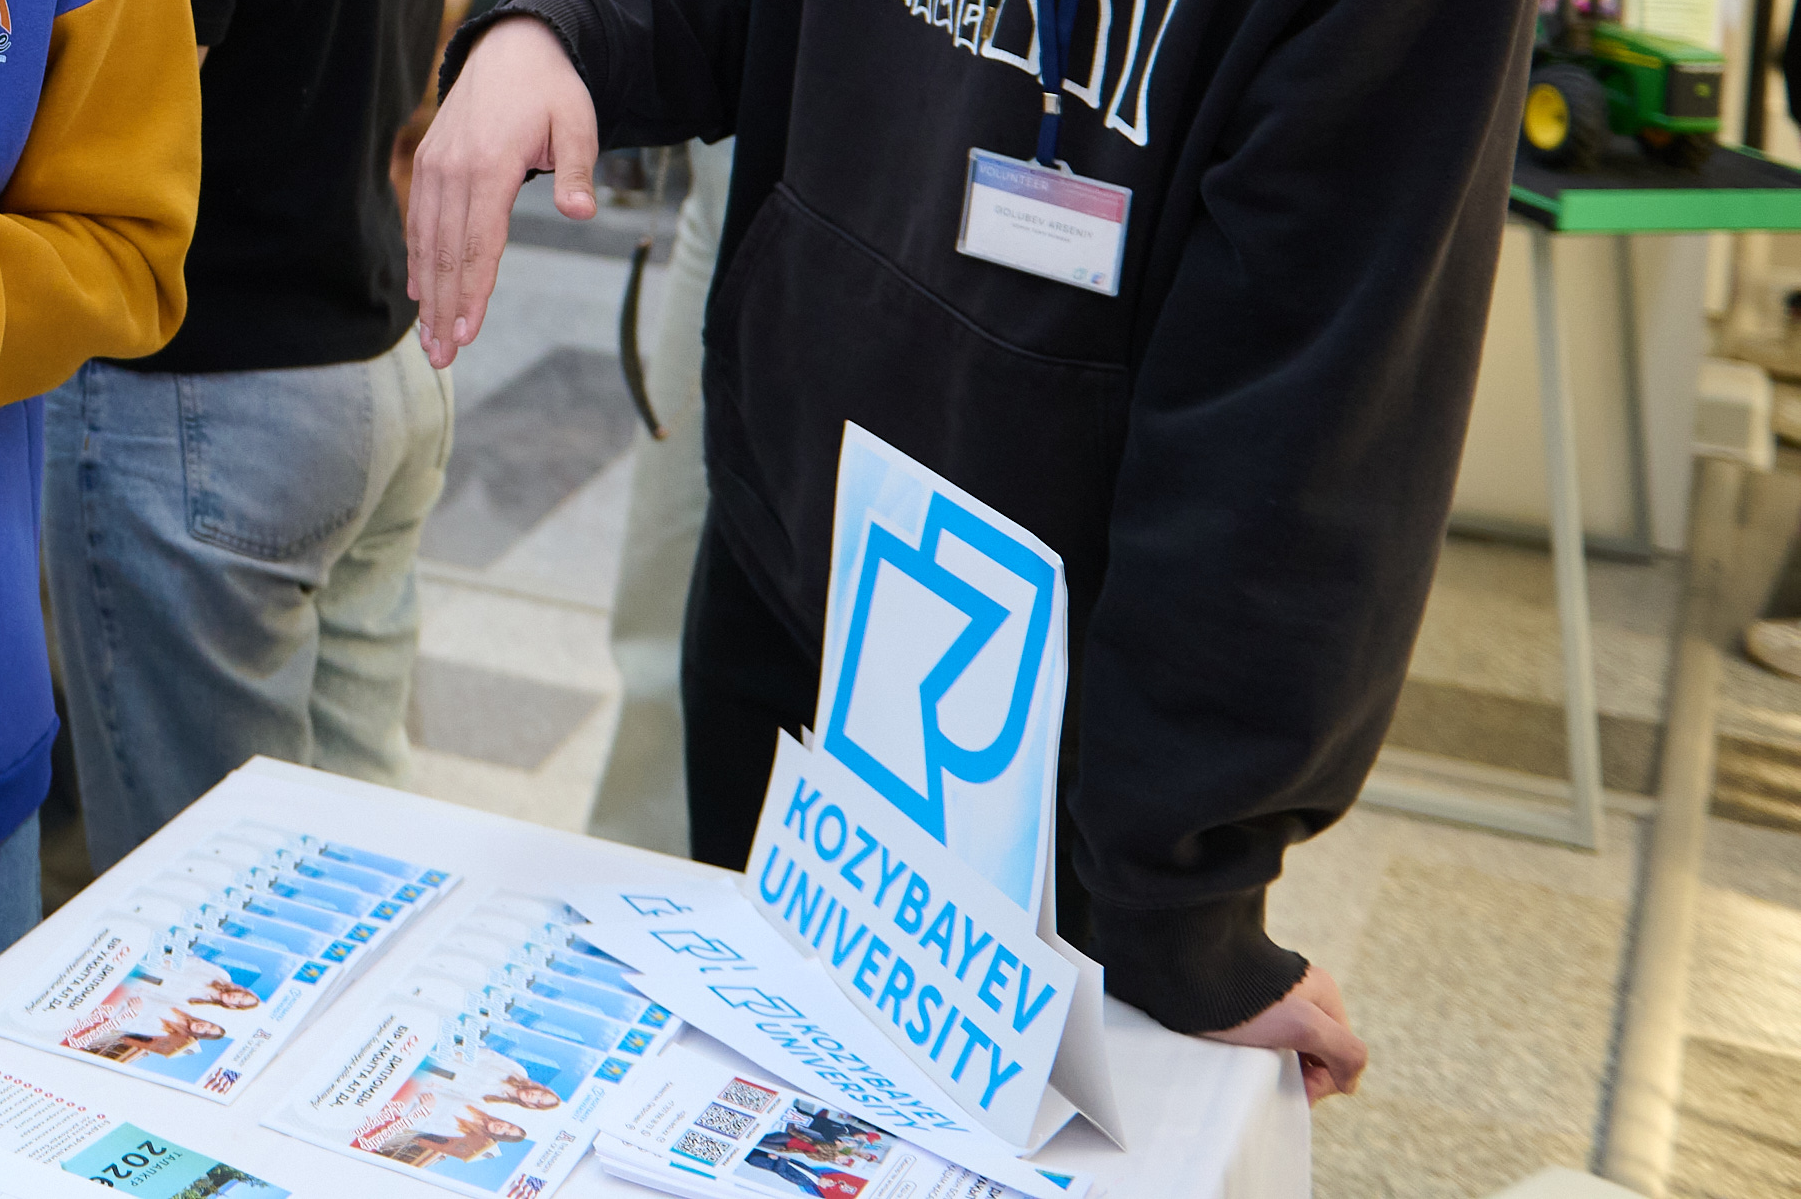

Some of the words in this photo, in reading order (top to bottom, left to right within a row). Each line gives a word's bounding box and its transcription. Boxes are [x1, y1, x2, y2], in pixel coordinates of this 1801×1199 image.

[979, 166, 1049, 191] VOLUNTEER
[783, 776, 1058, 1035] KOZYBAYEV
[58, 986, 73, 999] АЛ
[66, 964, 113, 1010] ДИПЛОМДЫ
[759, 844, 1024, 1112] UNIVERSITY
[392, 1024, 408, 1038] БІР
[357, 1040, 394, 1079] УАҚЫТТА
[756, 1022, 931, 1133] UNIVERSITY
[792, 1024, 970, 1133] KOZYBAYEV
[345, 1079, 359, 1093] АЛ
[353, 1055, 402, 1108] ДИПЛОМДЫ
[356, 1115, 413, 1151] University
[129, 1150, 182, 1186] ТАЛАПКЕР
